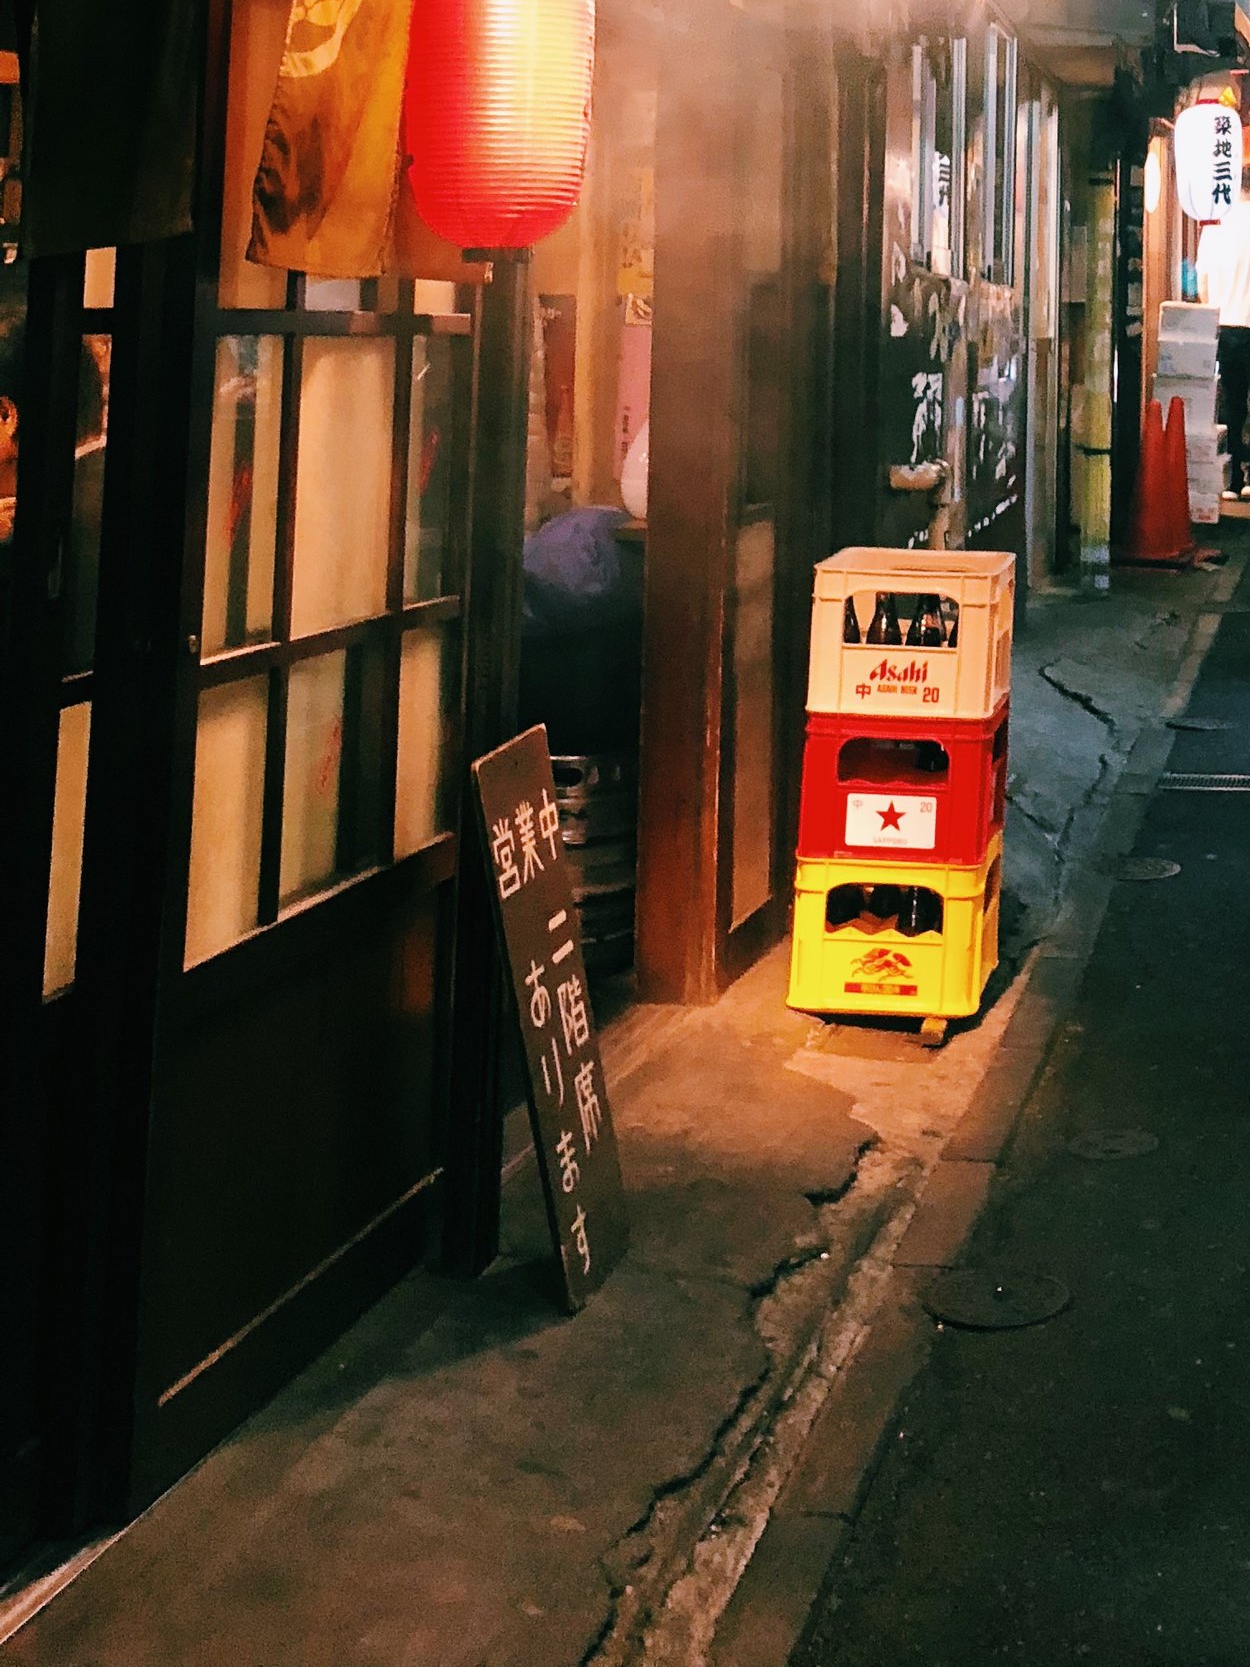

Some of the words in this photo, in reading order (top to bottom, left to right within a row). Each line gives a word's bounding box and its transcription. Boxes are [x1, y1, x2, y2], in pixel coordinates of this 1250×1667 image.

[855, 683, 872, 700] 中
[922, 687, 940, 703] 20
[869, 658, 929, 683] Asahi
[920, 802, 933, 813] 20
[492, 789, 559, 900] 営業中
[548, 909, 601, 1156] 二階席
[525, 960, 591, 1275] あります
